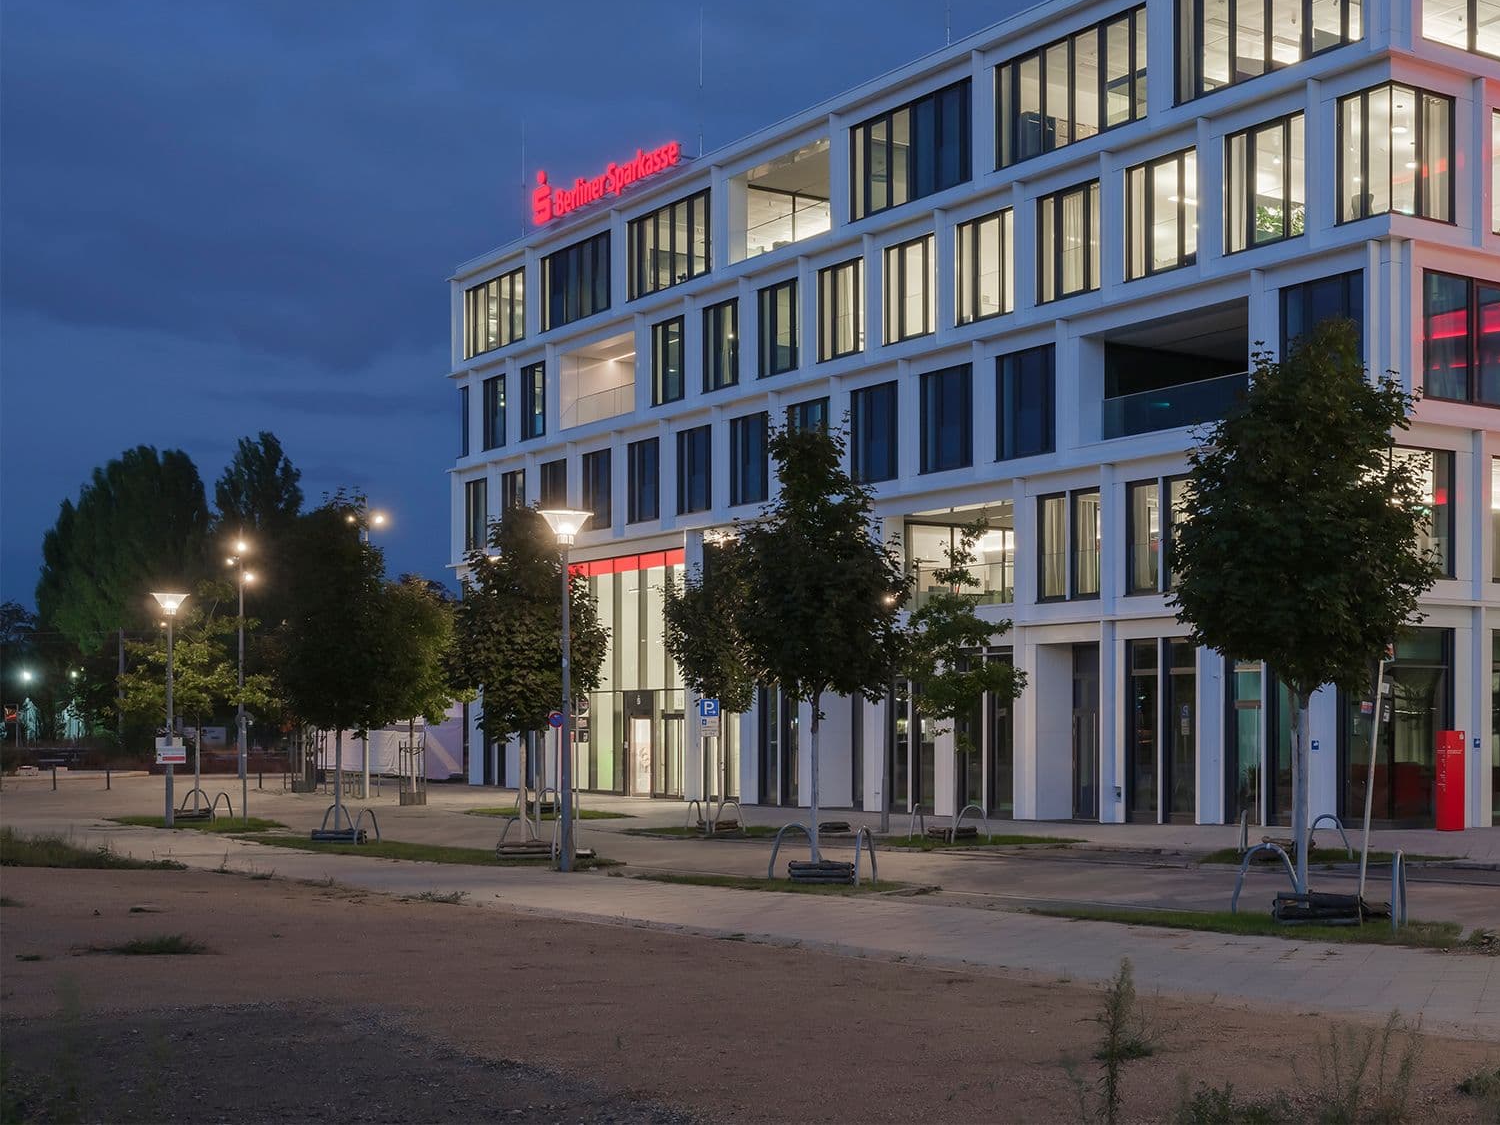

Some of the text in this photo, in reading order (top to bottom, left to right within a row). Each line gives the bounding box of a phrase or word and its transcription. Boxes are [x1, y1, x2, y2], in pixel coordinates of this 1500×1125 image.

[555, 177, 606, 217] Berliner
[607, 141, 681, 196] Sparkasse
[704, 701, 715, 715] P
